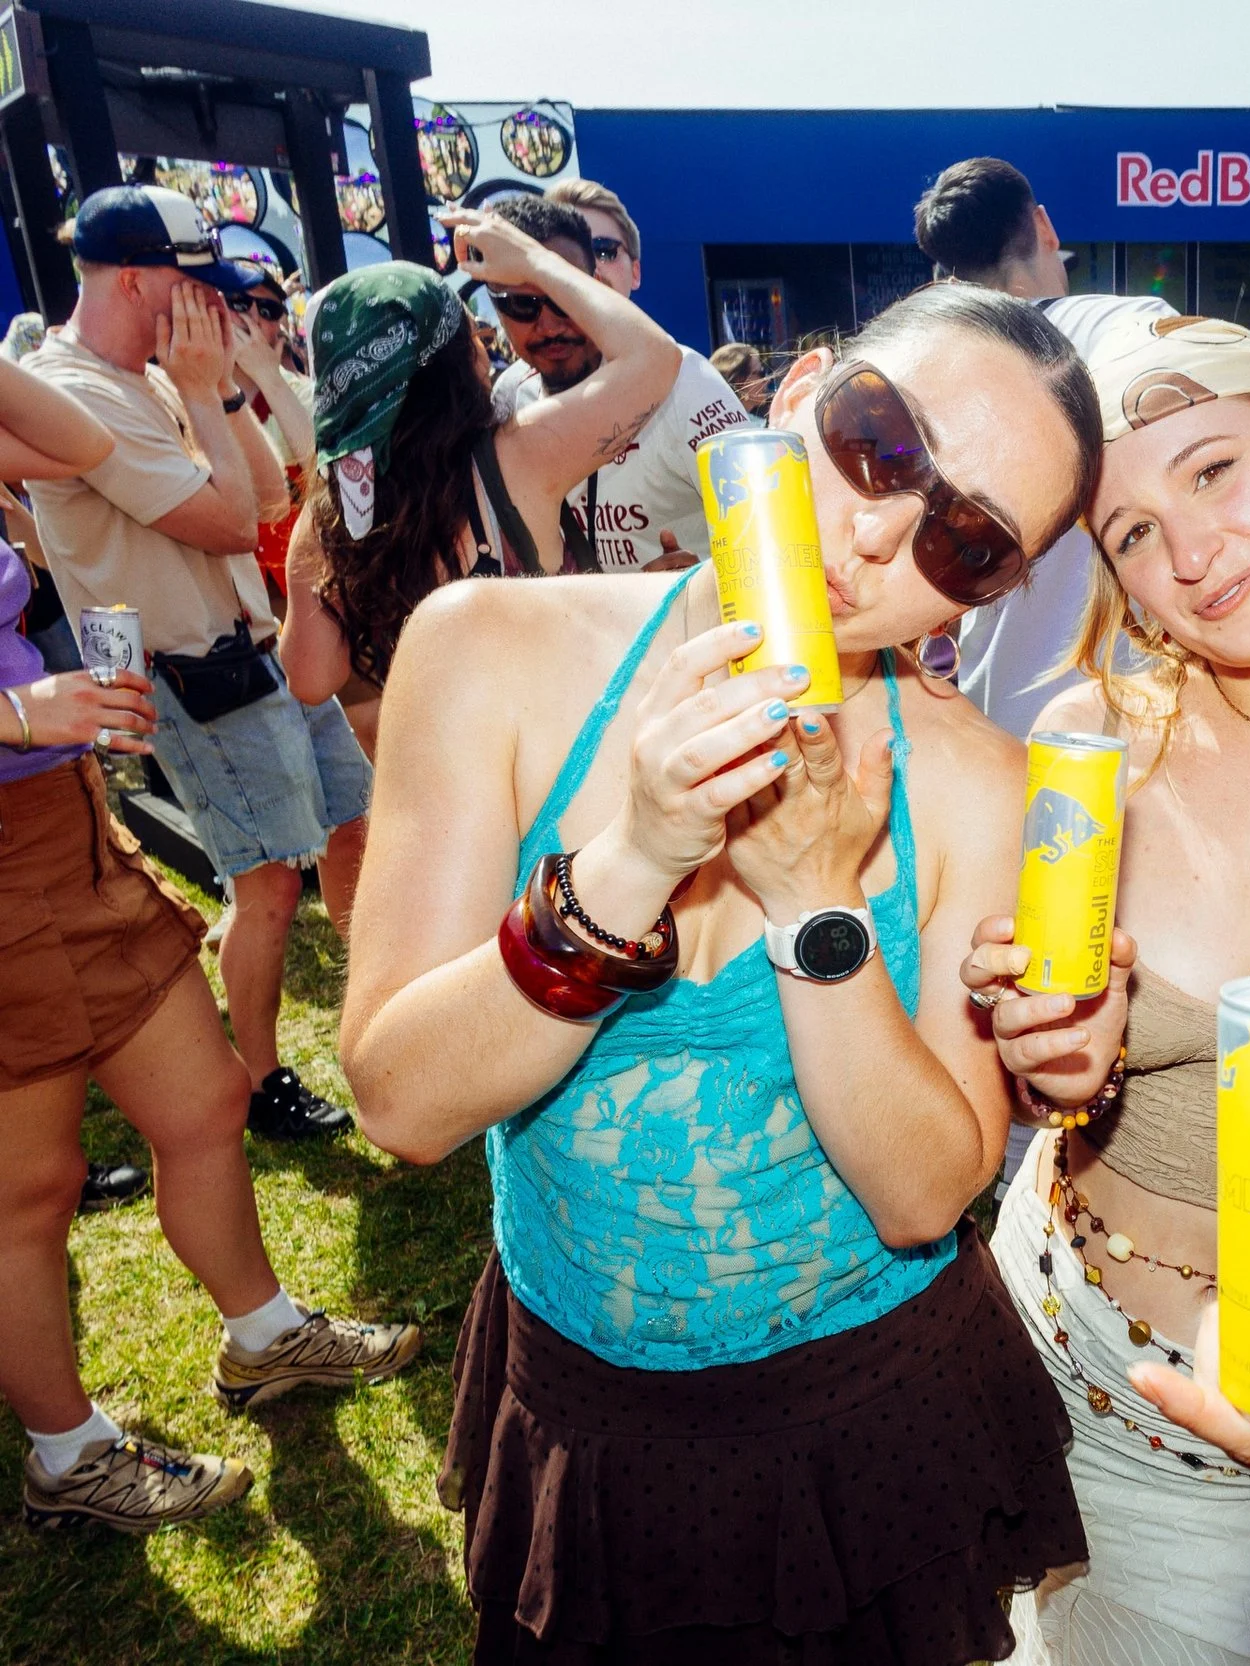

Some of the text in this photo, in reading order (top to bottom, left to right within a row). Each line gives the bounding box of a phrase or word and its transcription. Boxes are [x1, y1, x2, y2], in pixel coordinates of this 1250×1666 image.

[1117, 150, 1213, 206] Red
[689, 399, 726, 427] VISIT
[712, 537, 728, 549] THE
[719, 575, 761, 595] EDITIO
[90, 623, 128, 641] CLAW
[1096, 837, 1117, 846] THE
[1084, 894, 1109, 989] Red Bull
